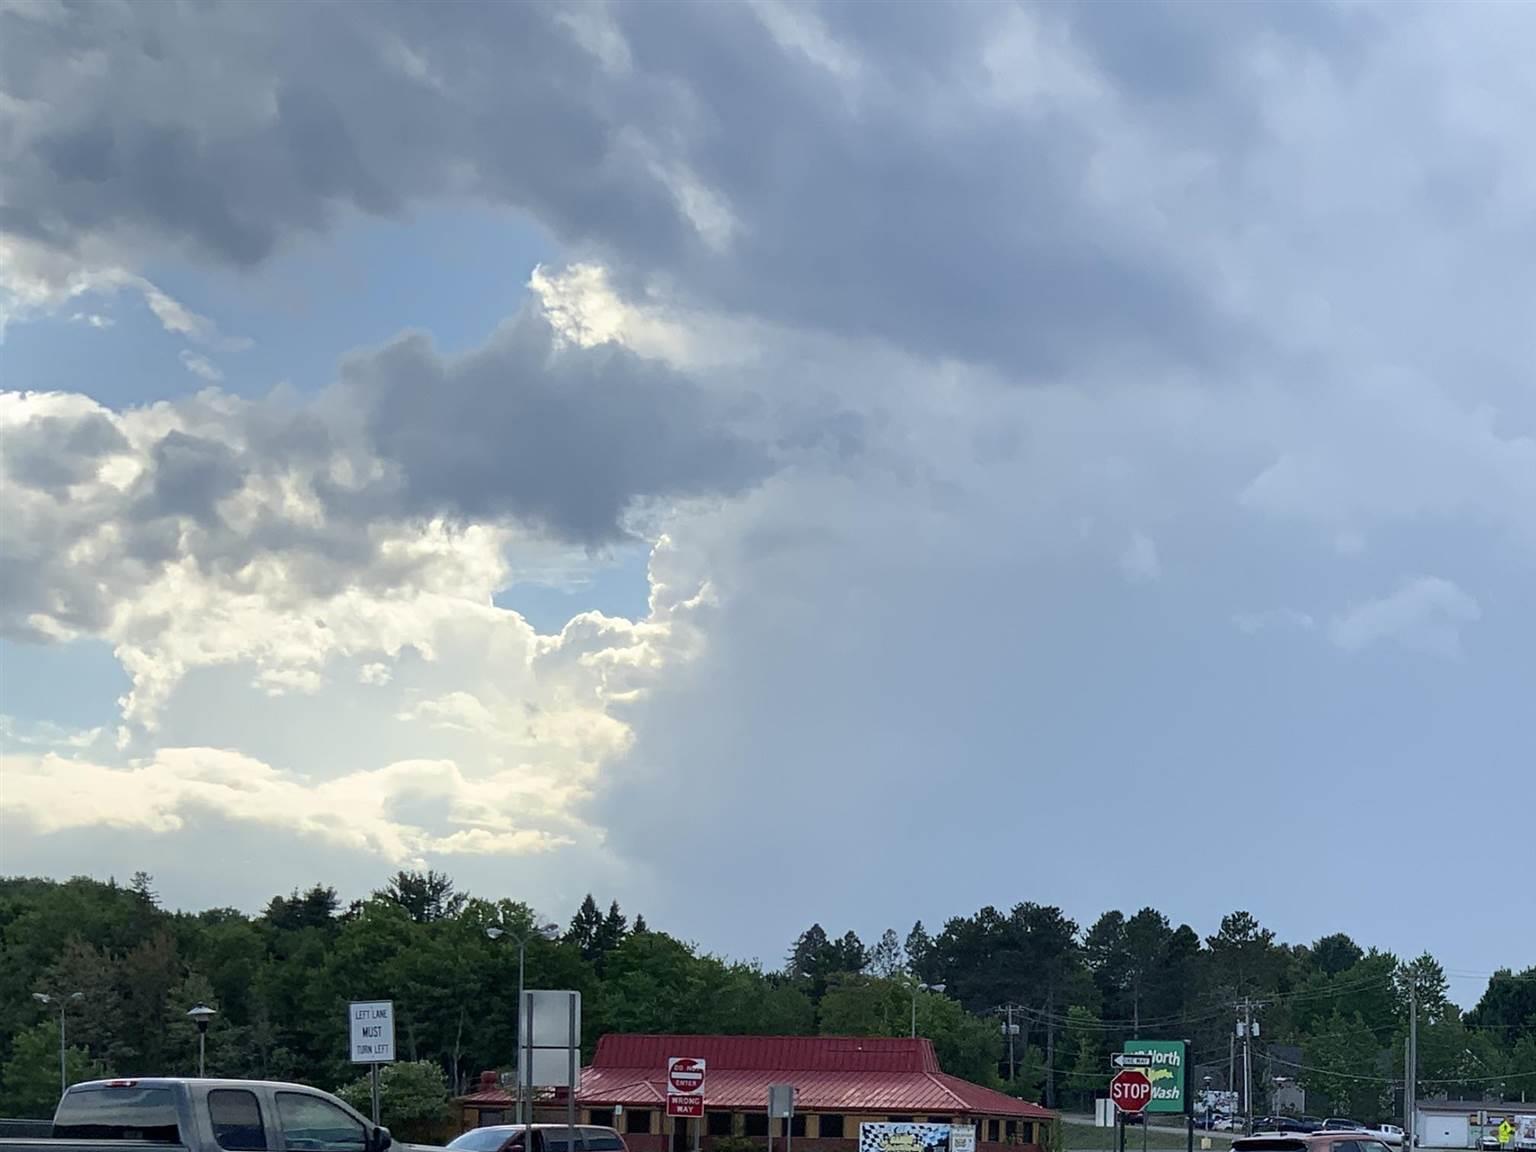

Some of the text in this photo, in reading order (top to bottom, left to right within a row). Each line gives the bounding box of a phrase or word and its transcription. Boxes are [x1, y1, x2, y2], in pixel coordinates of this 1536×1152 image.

[355, 1009, 387, 1020] LEFT LANE
[362, 1026, 382, 1038] MUST
[357, 1044, 389, 1055] TURN LEFT
[1149, 1049, 1180, 1066] North
[675, 1079, 697, 1087] ENTER
[1113, 1083, 1150, 1099] STOP
[1151, 1086, 1180, 1099] Wash
[671, 1097, 700, 1105] WRONG
[676, 1105, 694, 1113] WAY
